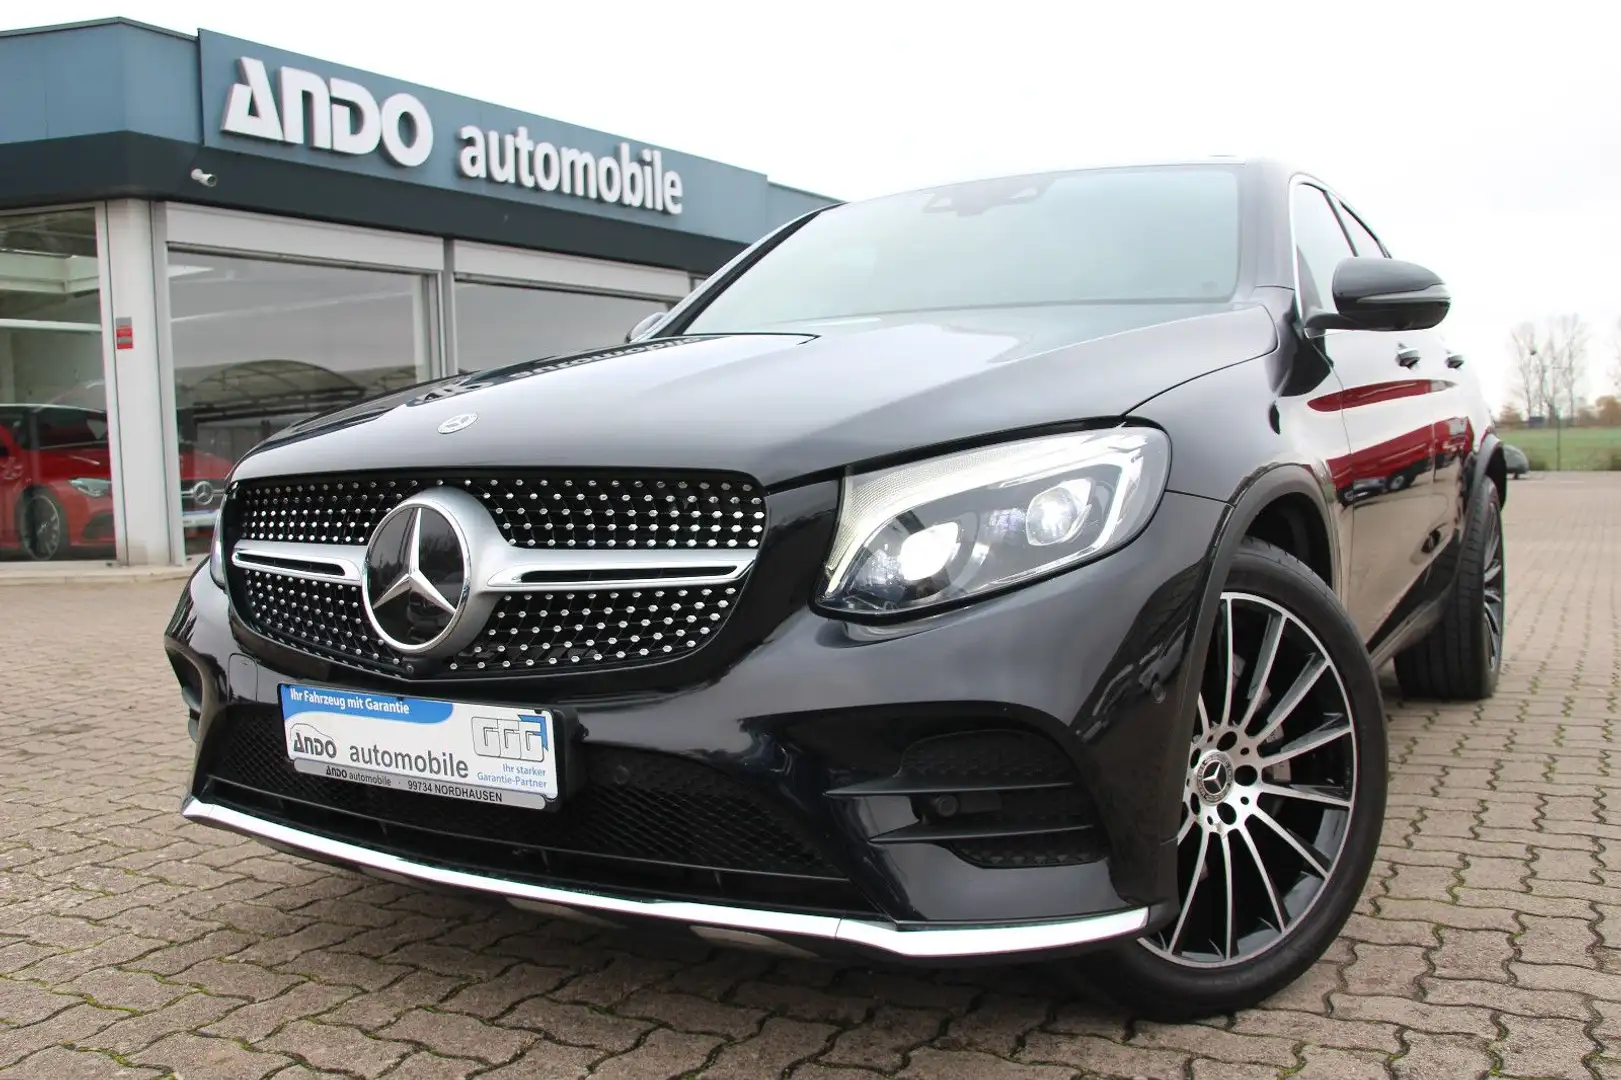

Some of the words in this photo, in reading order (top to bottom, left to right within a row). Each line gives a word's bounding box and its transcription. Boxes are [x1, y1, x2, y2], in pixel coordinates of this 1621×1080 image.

[220, 56, 434, 168] ANDO
[458, 125, 684, 215] automobile
[290, 687, 303, 701] Ihr
[304, 690, 346, 710] Fahrzeug
[347, 697, 364, 709] mit
[365, 698, 410, 714] Garantie
[293, 731, 338, 759] ANDO
[349, 744, 469, 779] automobile
[502, 763, 515, 773] Ihr
[516, 764, 547, 777] starker
[325, 765, 348, 779] ANDO
[348, 766, 392, 787] automobile
[407, 780, 433, 793] 99734
[434, 783, 503, 803] NORDHAUSEN
[477, 771, 548, 789] Garantie-Partner
